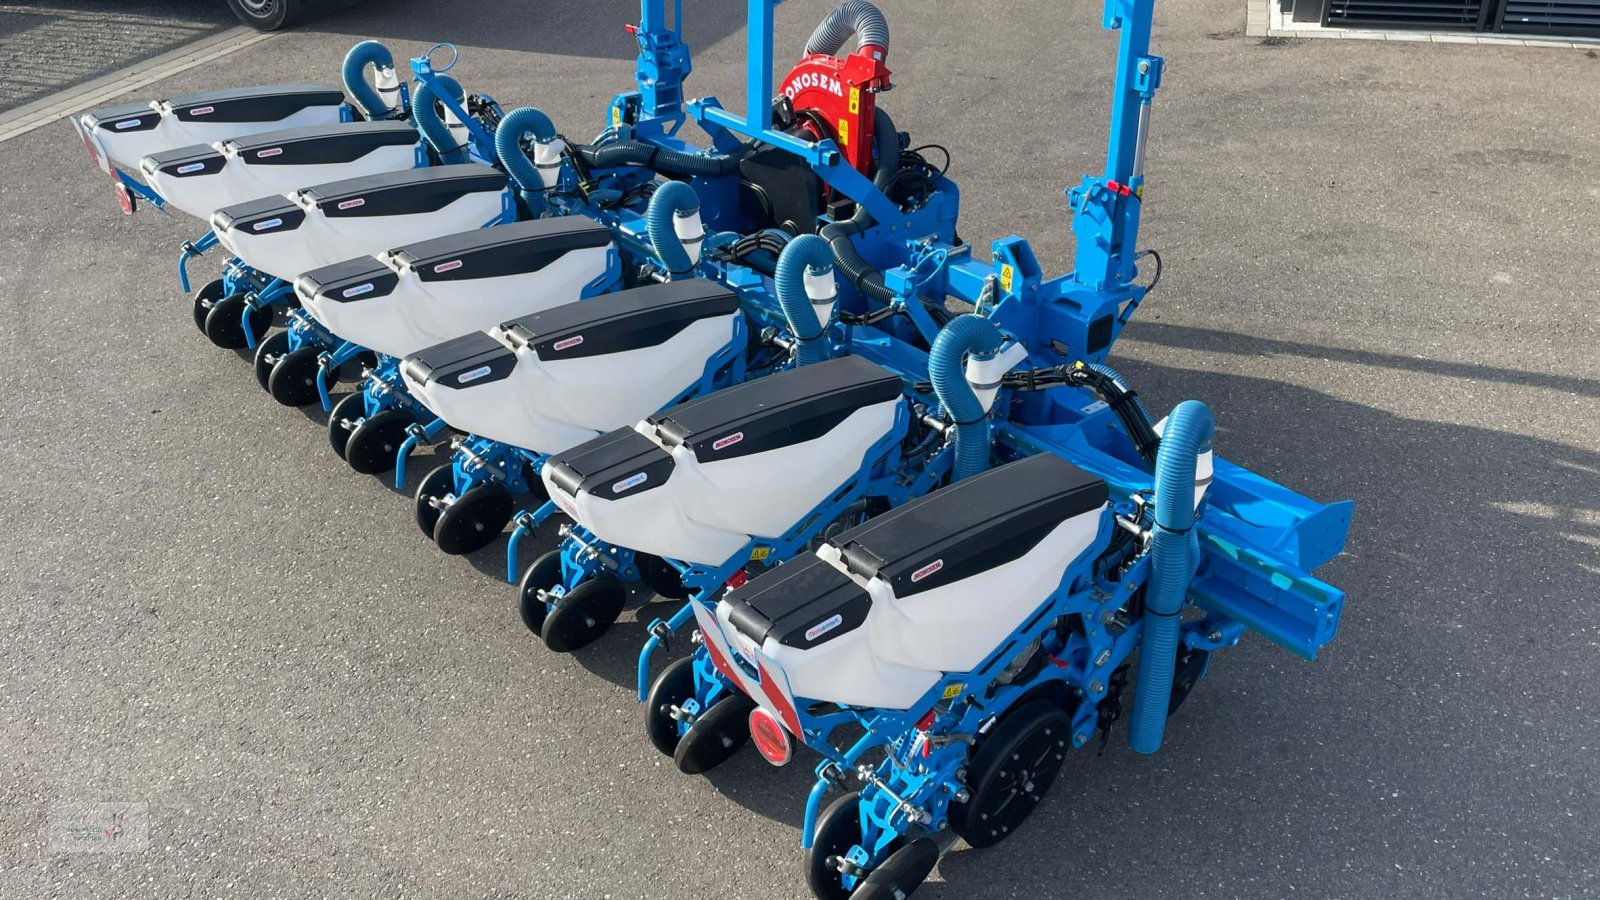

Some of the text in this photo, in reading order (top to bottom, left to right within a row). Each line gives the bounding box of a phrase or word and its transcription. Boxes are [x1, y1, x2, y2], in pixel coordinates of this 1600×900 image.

[785, 72, 843, 100] ONOSEM
[714, 434, 742, 449] MONOSEM
[913, 561, 942, 581] MONOSEM
